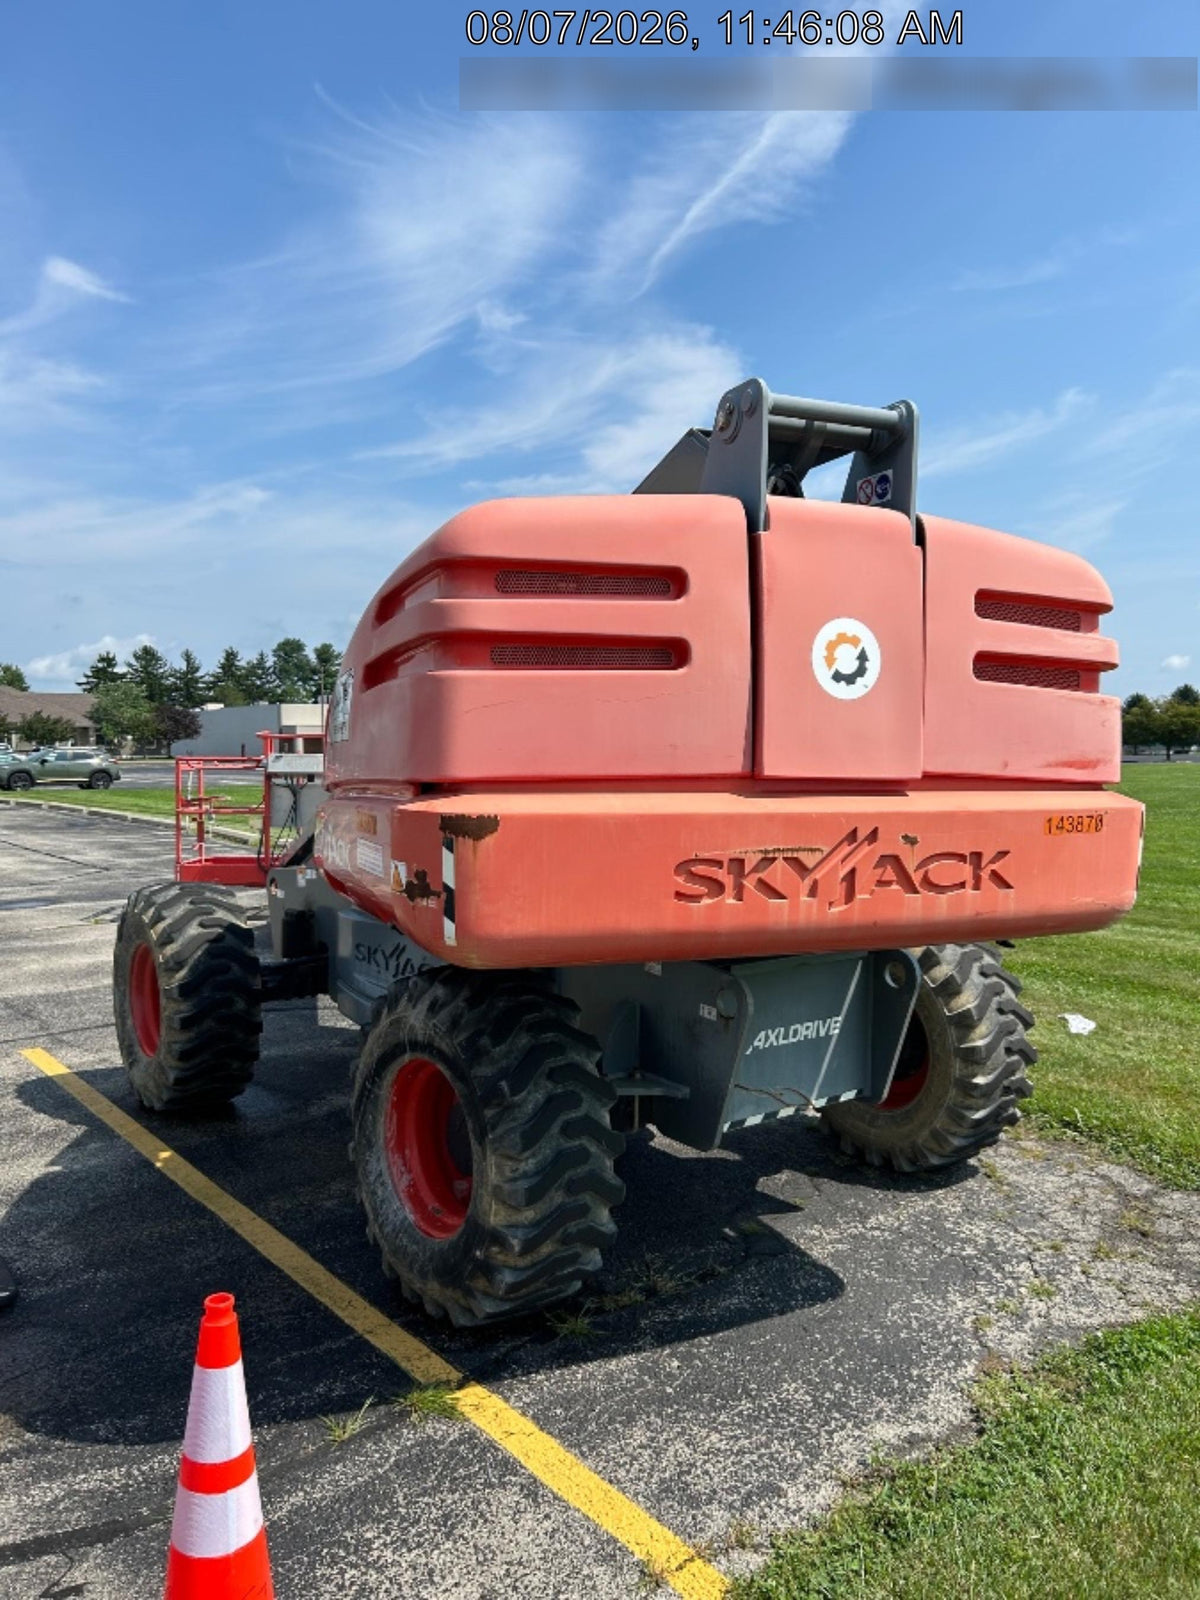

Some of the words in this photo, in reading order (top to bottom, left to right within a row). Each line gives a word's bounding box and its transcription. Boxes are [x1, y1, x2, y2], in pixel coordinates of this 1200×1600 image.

[1046, 813, 1104, 834] 143870
[673, 825, 1015, 912] SKYJACK
[354, 941, 431, 979] SKYJAC
